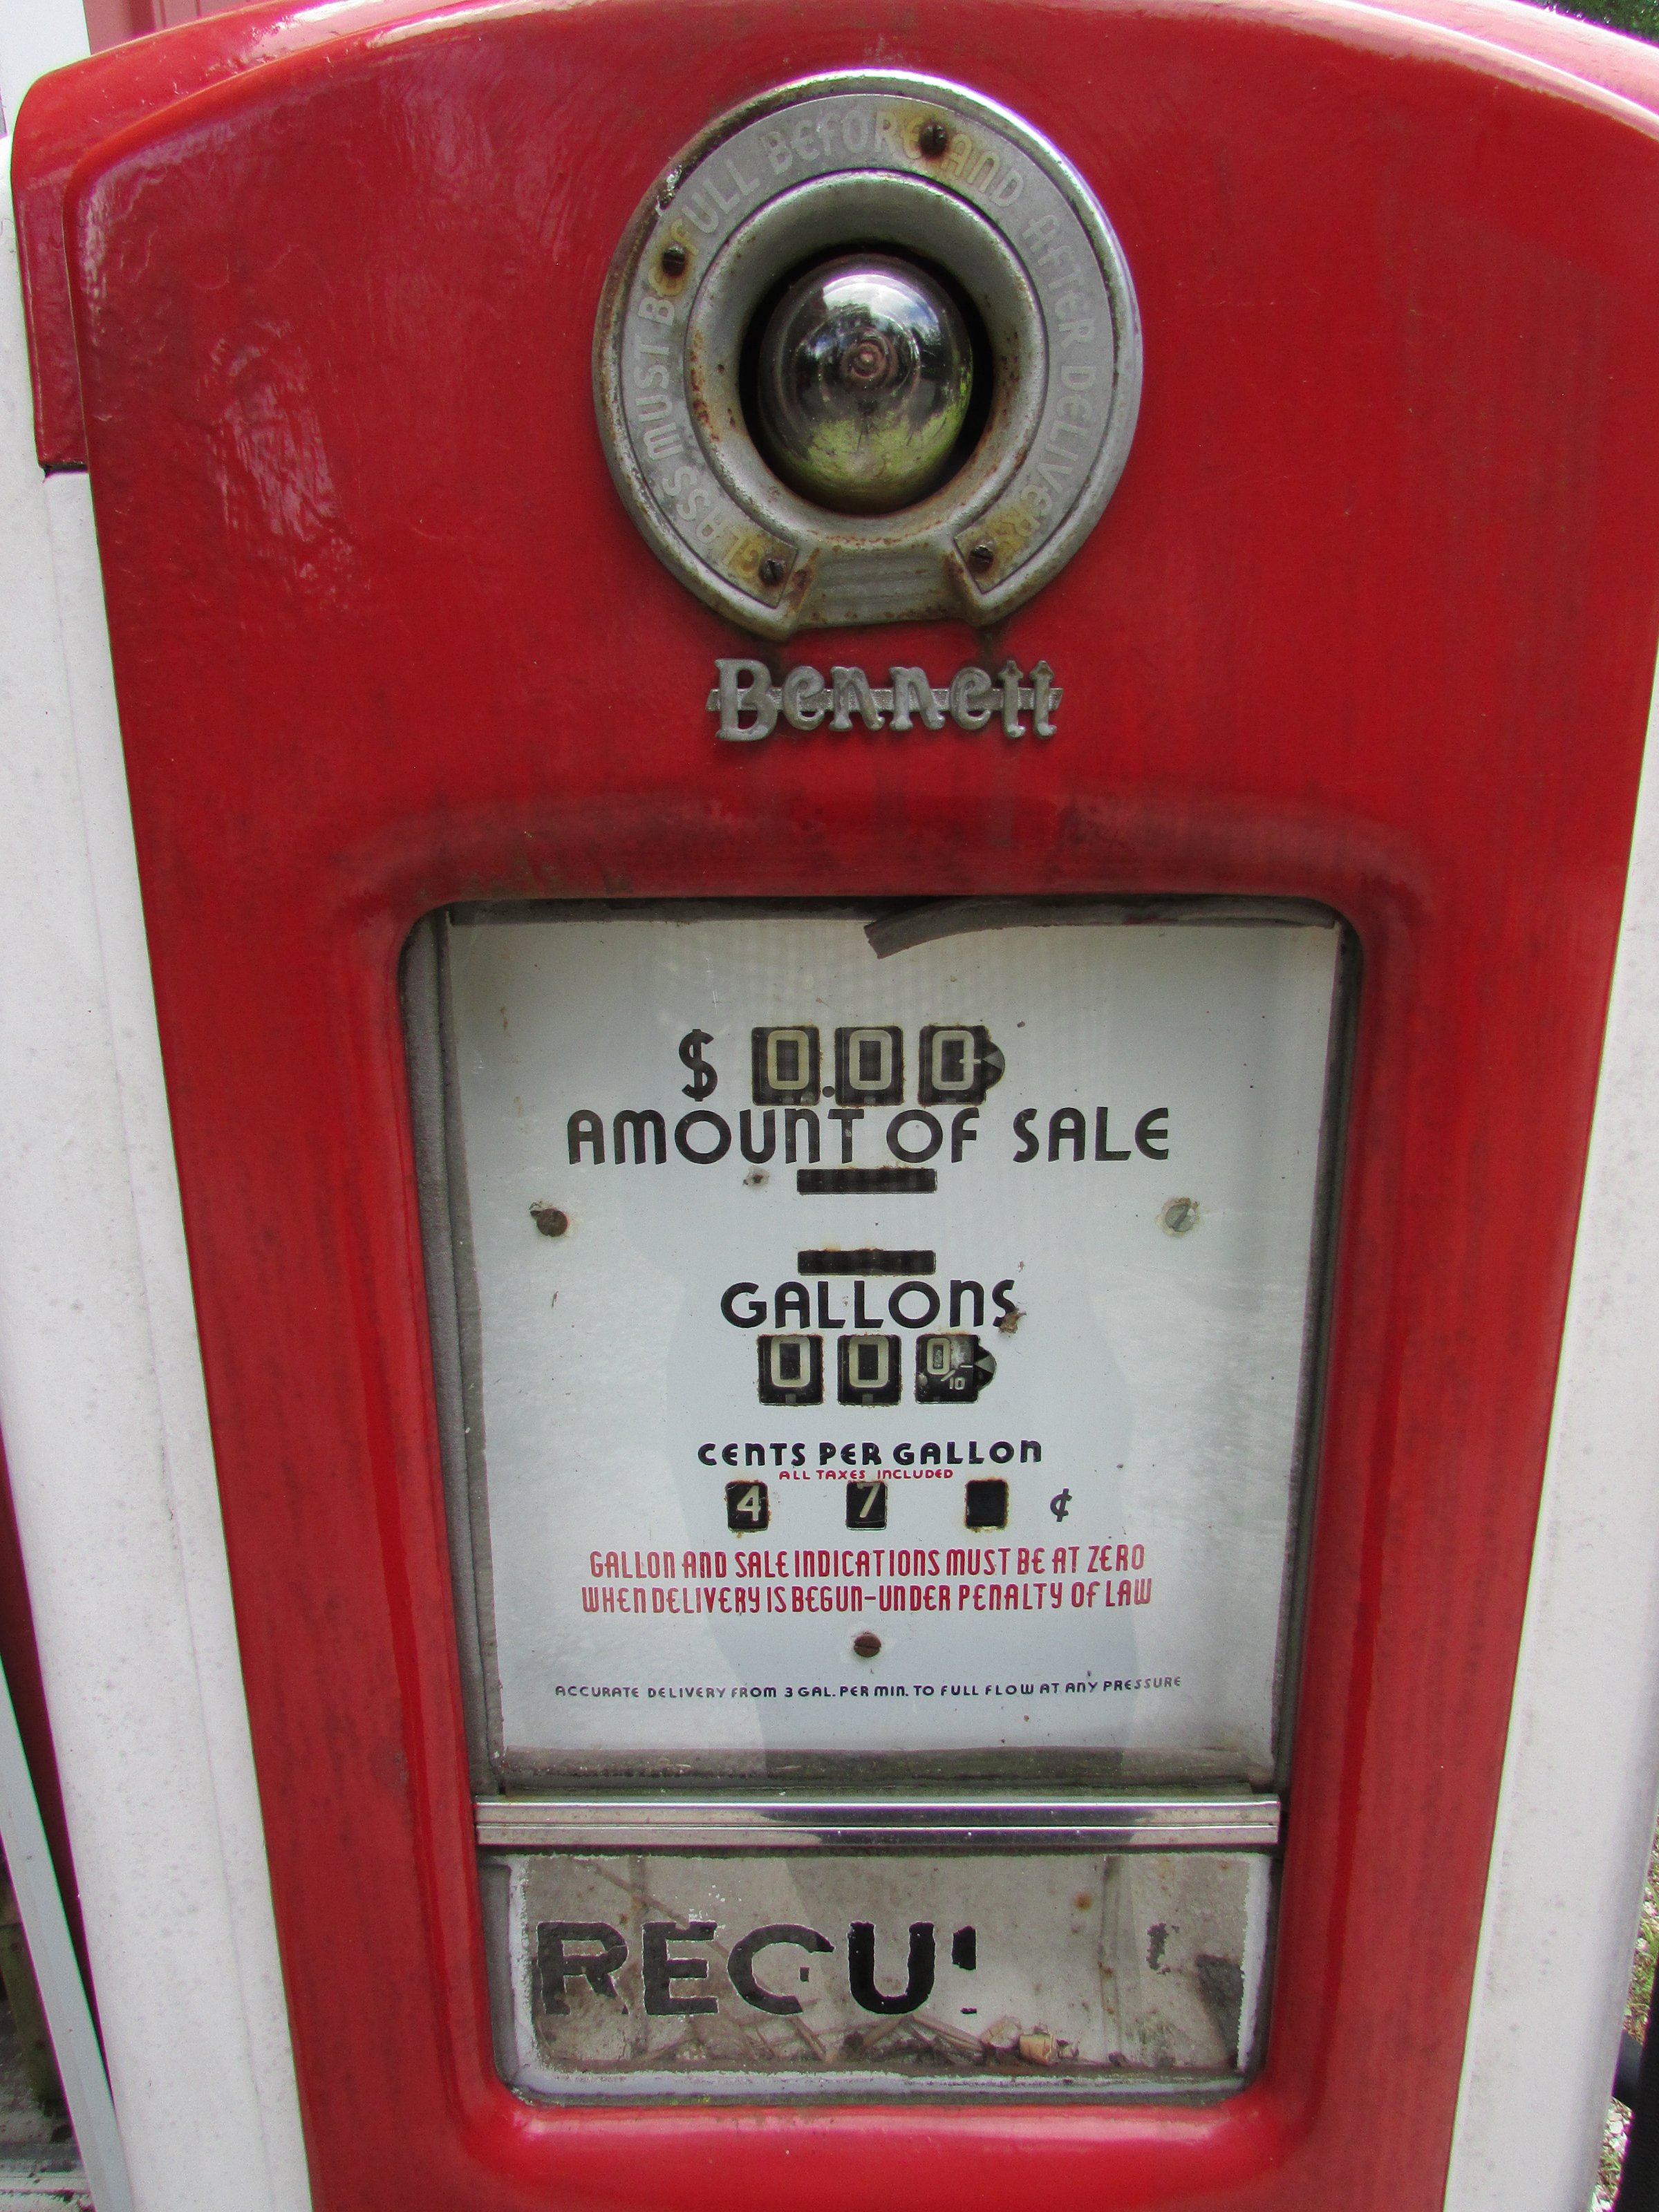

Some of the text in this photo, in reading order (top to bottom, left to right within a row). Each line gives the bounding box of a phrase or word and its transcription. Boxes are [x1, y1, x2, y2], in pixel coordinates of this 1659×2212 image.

[634, 334, 684, 460] MUST
[670, 160, 760, 257] FULL
[940, 133, 1024, 208] AND
[1022, 214, 1096, 348] AFTER
[712, 658, 1059, 742] Bennett
[678, 1029, 718, 1103] $
[567, 1106, 1170, 1165] AMOUNT OF SALE
[720, 1279, 1016, 1329] GALLONS
[697, 1440, 1042, 1467] CENTS PER GALLON
[778, 1468, 954, 1481] ALL TAXES INCLUDED
[736, 1484, 761, 1521] 4
[856, 1481, 881, 1519] 7
[590, 1543, 1145, 1579] GALLON AND SALE INDICATIONS MUST BE AT ZERO
[581, 1586, 646, 1613] WHEN
[652, 1586, 760, 1613] DELIVERY
[767, 1586, 787, 1613] IS
[958, 1582, 1063, 1611] PENALTY
[1071, 1580, 1101, 1608] OF
[1105, 1577, 1152, 1607] LAW
[554, 1676, 1182, 1698] ACCURATE DELIVERY FROM 3 GAL. PER MIN. TO FULL FLOW AT ANY PRESSURE
